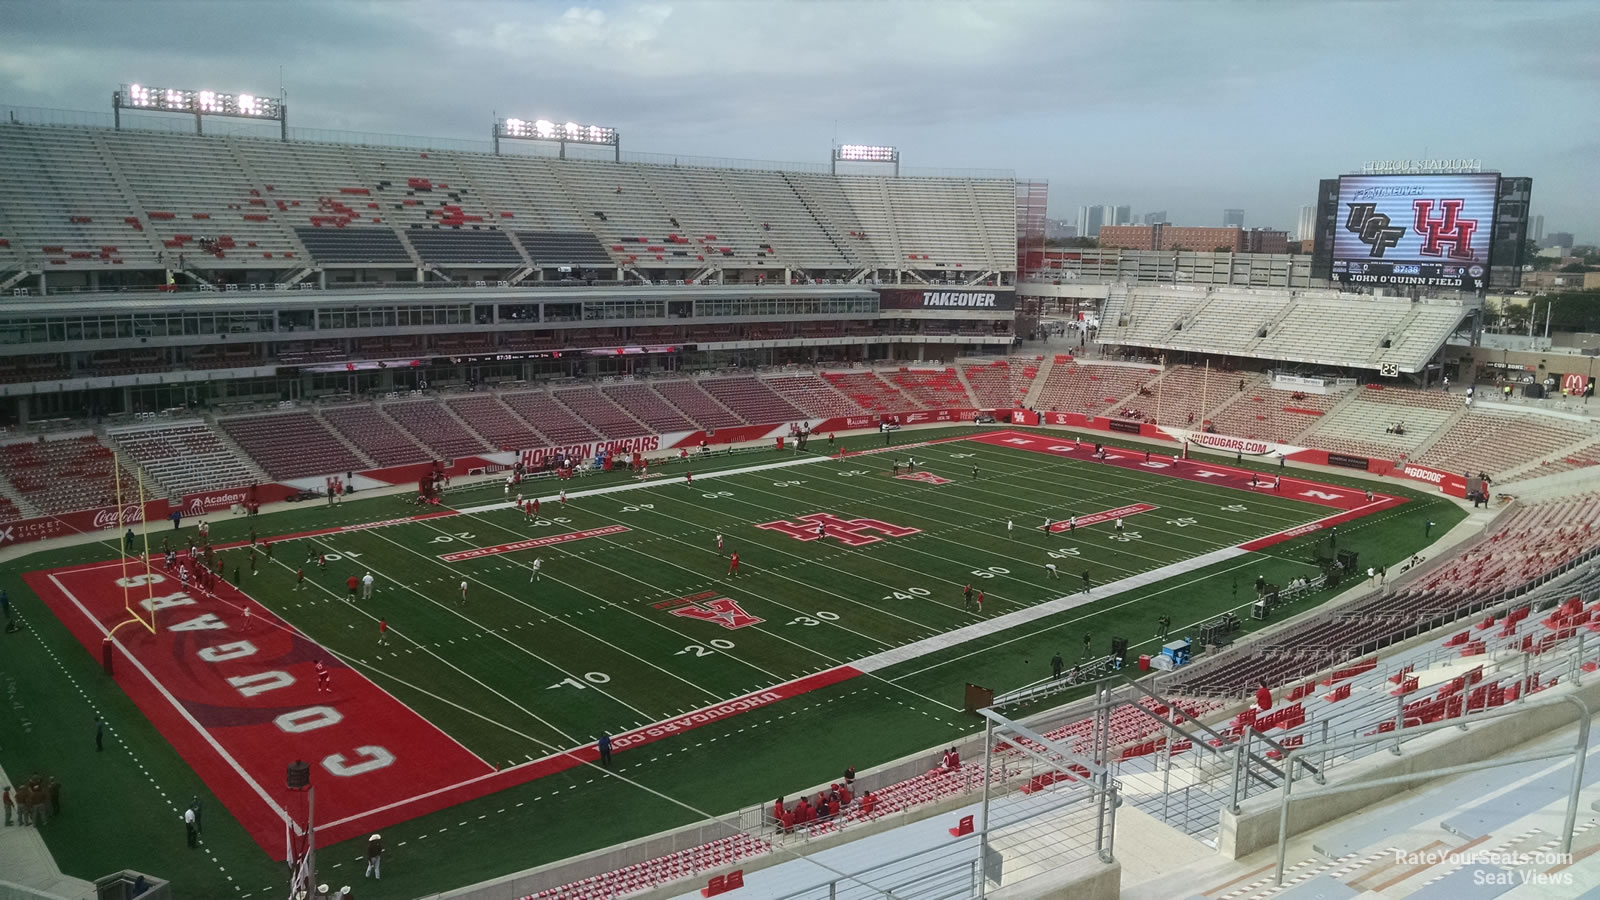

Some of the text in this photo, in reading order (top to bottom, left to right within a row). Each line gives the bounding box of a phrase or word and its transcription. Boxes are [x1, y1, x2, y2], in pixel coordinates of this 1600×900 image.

[1417, 159, 1474, 170] STADIUM
[1346, 203, 1407, 258] UCF
[1413, 199, 1478, 260] UH
[1394, 265, 1419, 274] 87:38
[1458, 267, 1465, 275] 0
[1350, 275, 1463, 287] JOHN O'QUINN FIELD
[923, 292, 995, 307] TAKEOVER
[1383, 364, 1397, 375] 25
[521, 435, 660, 468] HOUSTON COUGARS
[1002, 437, 1344, 500] HOUSTON
[93, 505, 146, 528] CocaCola
[18, 520, 61, 531] TICKET
[19, 527, 61, 538] GALAXY
[443, 526, 624, 562] JOHN O'QUINN FIELD
[971, 566, 1010, 579] 50
[892, 587, 932, 601] 40
[795, 611, 841, 627] 30
[685, 638, 736, 658] 20
[115, 573, 397, 777] COUGARS
[560, 671, 612, 690] 10
